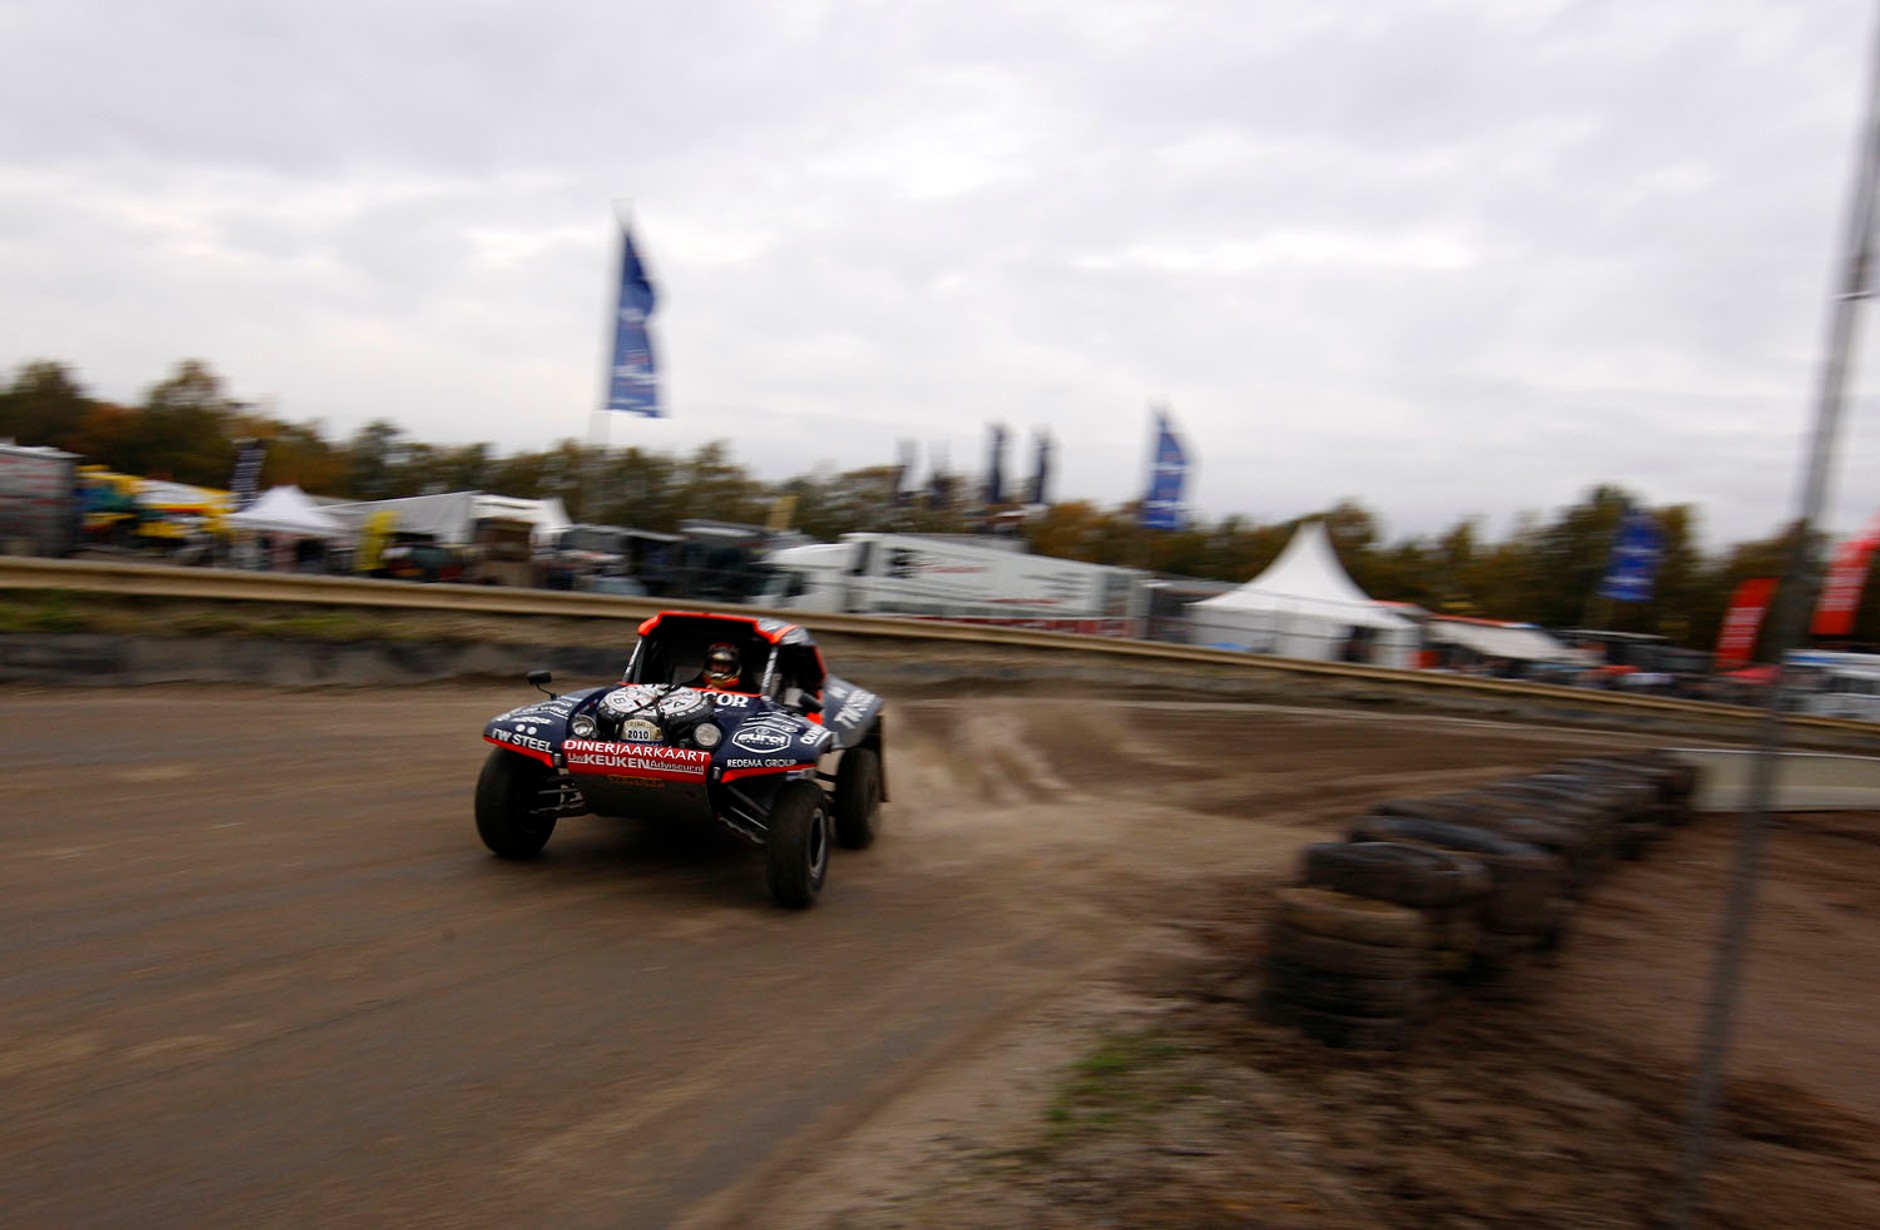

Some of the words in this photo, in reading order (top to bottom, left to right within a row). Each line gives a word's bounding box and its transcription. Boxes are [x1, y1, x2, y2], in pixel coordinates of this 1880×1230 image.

[492, 728, 512, 743] TW
[511, 733, 553, 754] STEEL
[627, 730, 649, 740] 2010
[737, 733, 786, 745] eurol
[563, 739, 710, 763] DINERJAARKAART
[726, 759, 763, 768] REDEMA
[764, 759, 797, 767] GROUP
